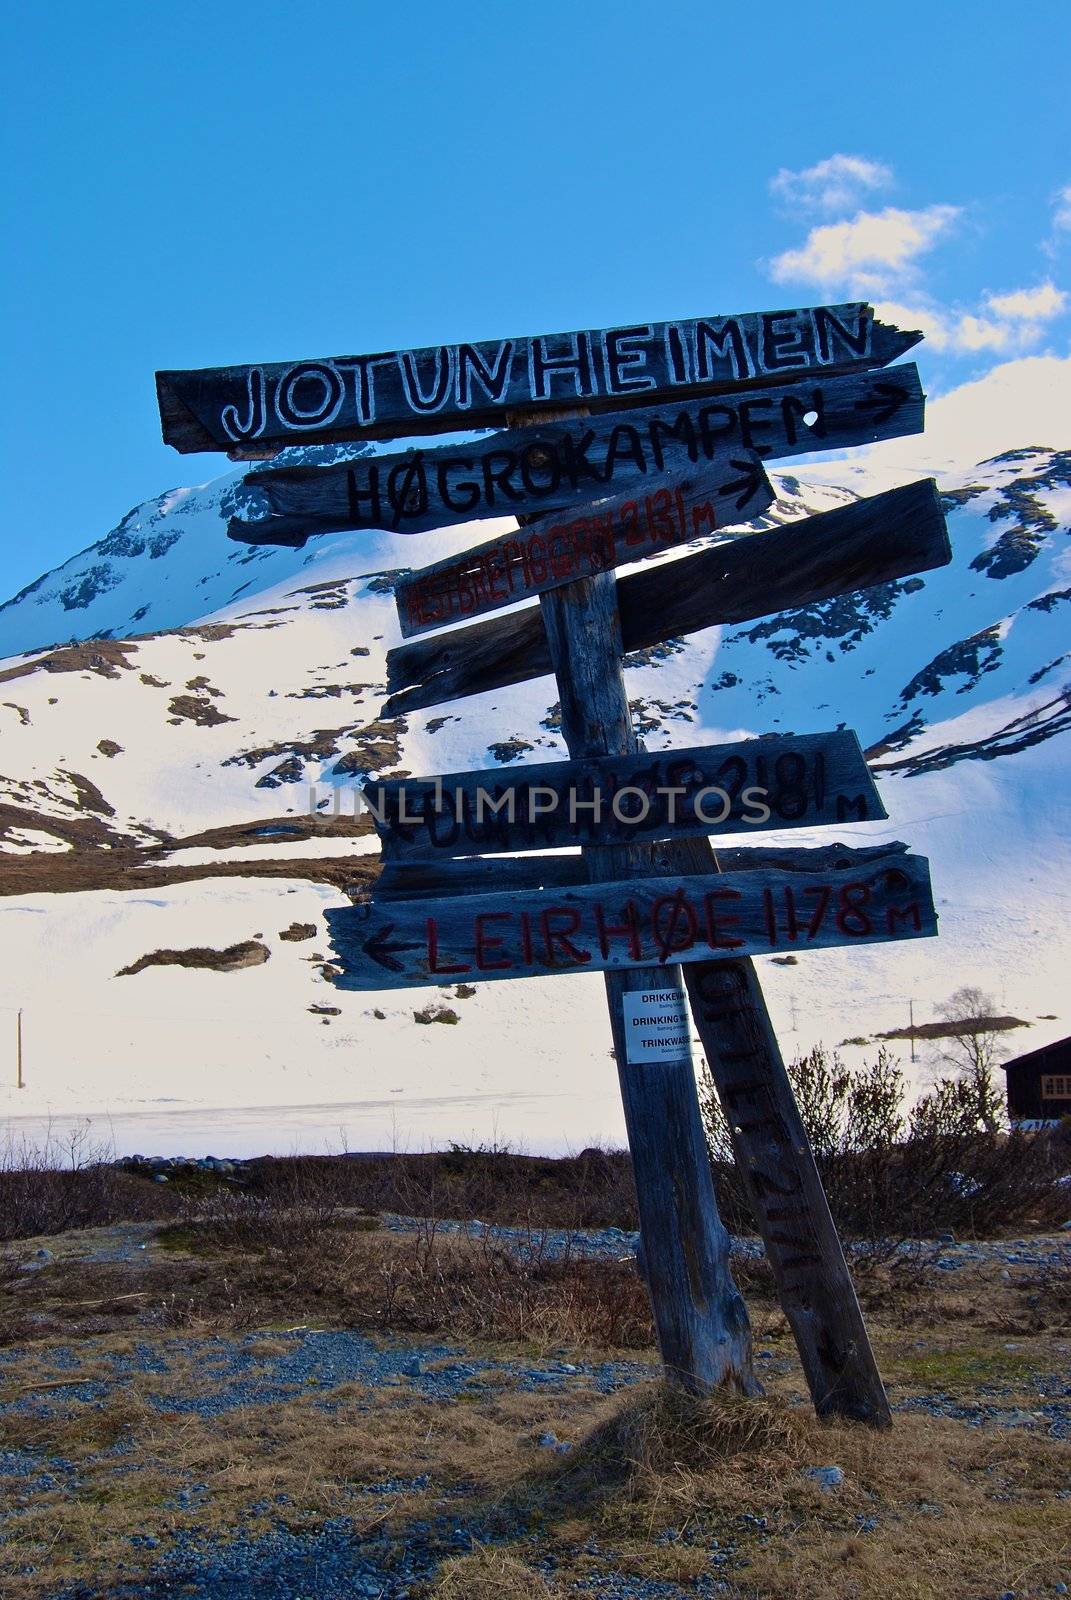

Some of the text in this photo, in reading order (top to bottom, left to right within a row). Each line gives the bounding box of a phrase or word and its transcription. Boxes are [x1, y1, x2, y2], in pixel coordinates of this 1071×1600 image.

[221, 306, 873, 441] JOTUNHEIMEN
[346, 388, 826, 531] HØGROKAMPEN
[619, 486, 688, 546] 2131
[426, 887, 746, 975] LEIRHØE
[763, 883, 873, 946] 1178
[632, 1014, 679, 1027] DRINKING
